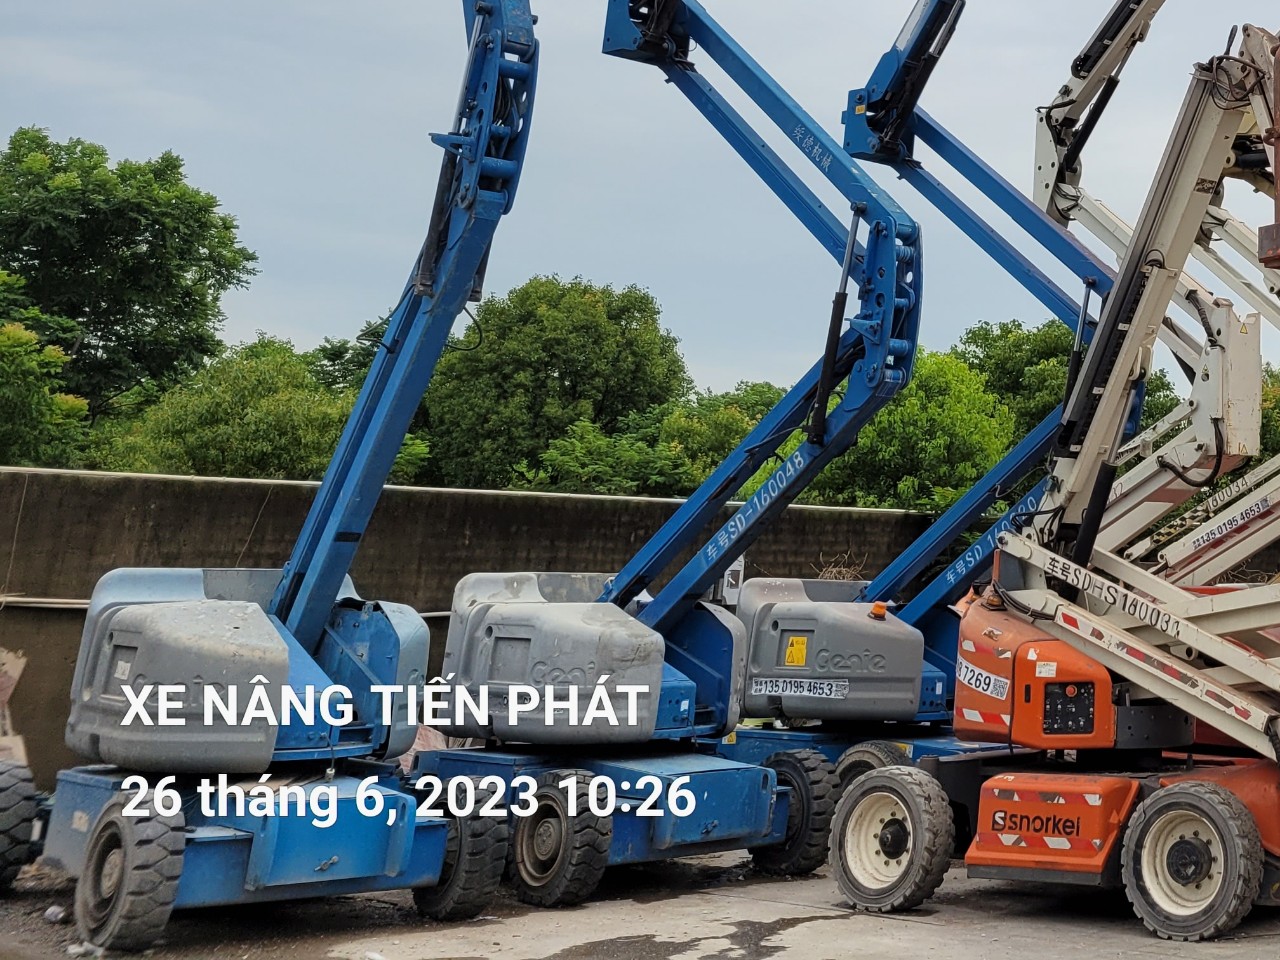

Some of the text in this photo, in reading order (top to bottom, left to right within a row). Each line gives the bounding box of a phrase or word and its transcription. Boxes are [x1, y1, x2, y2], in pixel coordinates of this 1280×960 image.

[1217, 515, 1239, 535] 0195
[1240, 502, 1261, 522] 4653
[763, 680, 780, 694] 135
[781, 680, 804, 695] 0195
[806, 681, 833, 697] 4653
[963, 665, 992, 692] 7269
